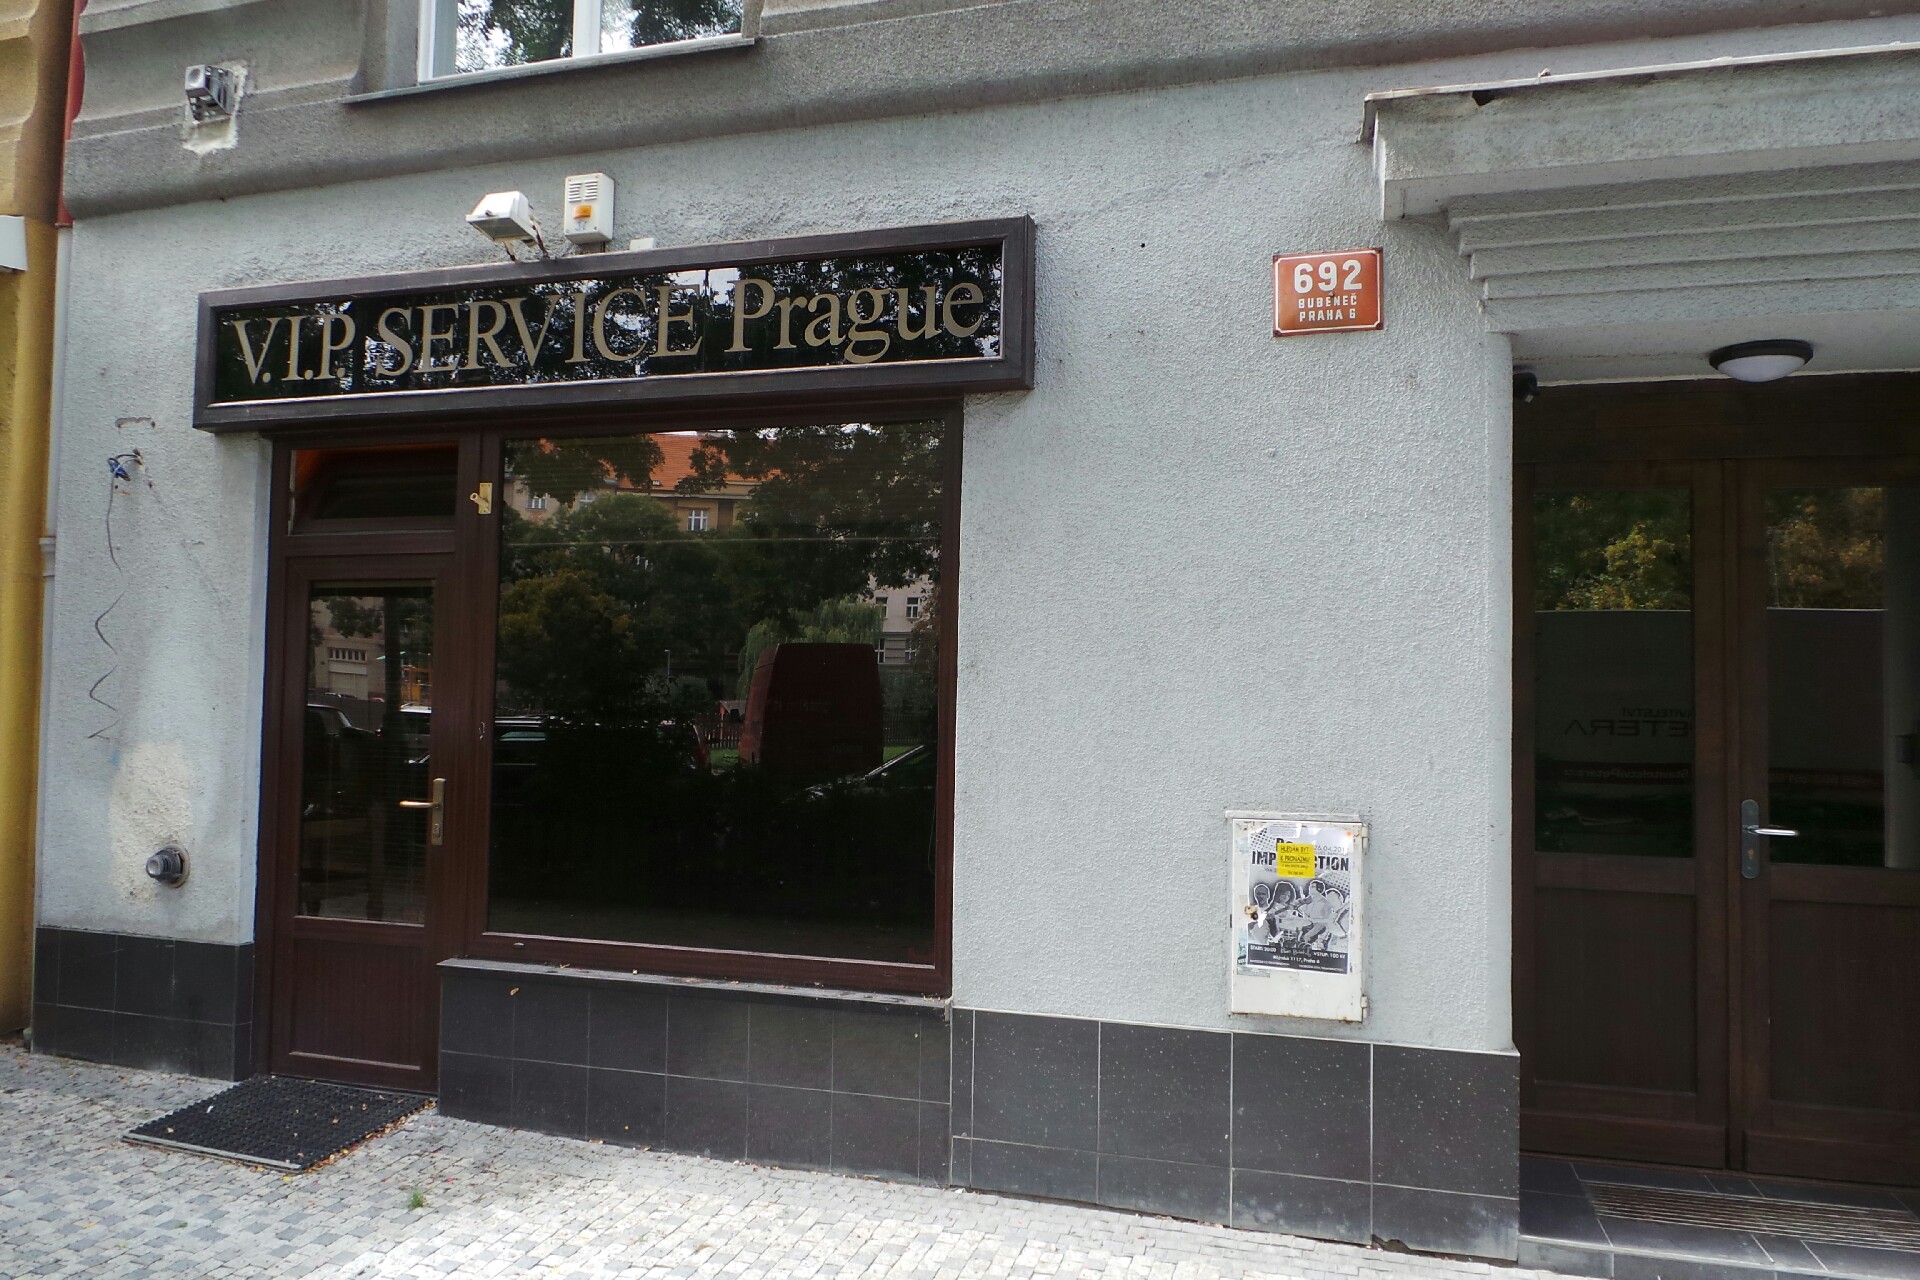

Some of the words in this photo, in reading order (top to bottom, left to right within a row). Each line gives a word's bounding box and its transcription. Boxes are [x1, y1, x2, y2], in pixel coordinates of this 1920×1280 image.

[1294, 259, 1362, 293] 692
[1298, 293, 1357, 309] BUBENEČ
[1299, 309, 1343, 322] PRAHA
[1349, 308, 1356, 319] 6
[232, 313, 355, 385] V.I.P.
[374, 284, 702, 377] SERVICE
[725, 279, 985, 366] Prague
